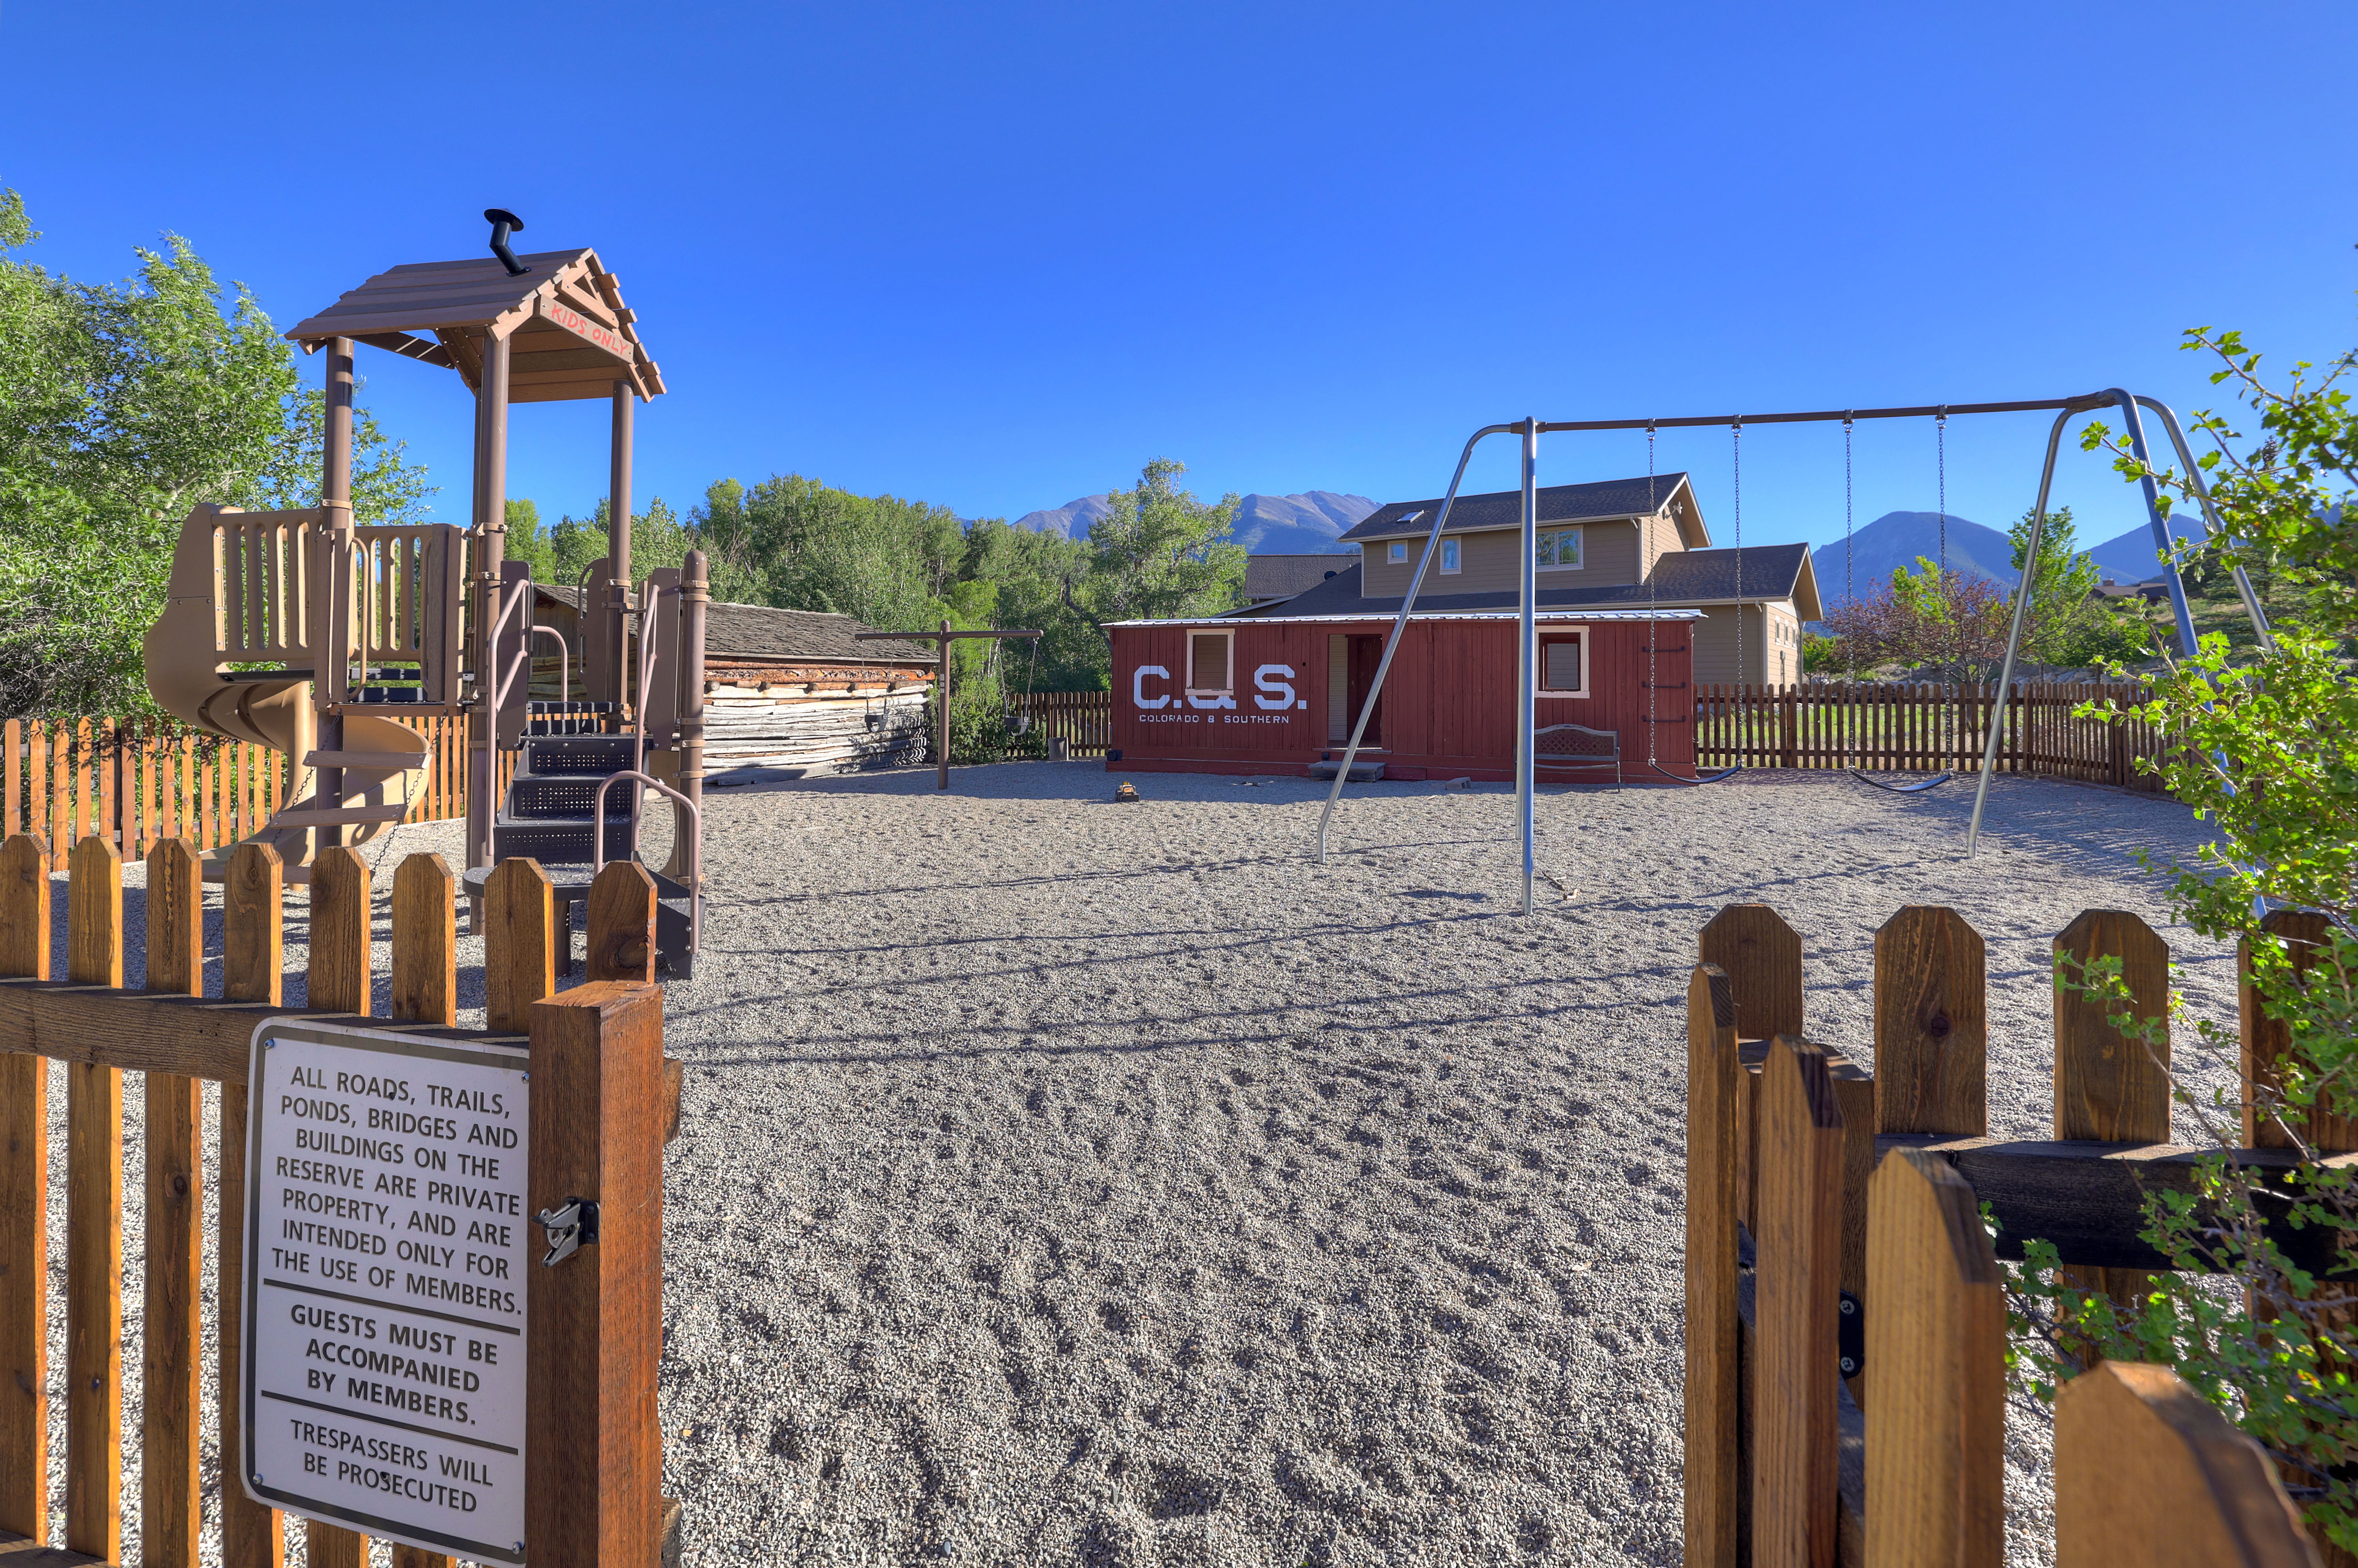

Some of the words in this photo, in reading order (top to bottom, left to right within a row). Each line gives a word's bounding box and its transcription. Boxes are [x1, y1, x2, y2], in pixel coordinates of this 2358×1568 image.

[552, 304, 587, 335] KIDS
[592, 328, 628, 355] ONLY
[1139, 714, 1199, 723] COLORADO
[1224, 715, 1289, 723] SOUTHERN
[291, 1066, 327, 1090] ALL
[337, 1072, 415, 1105] ROADS,
[428, 1084, 510, 1119] TRAILS,
[281, 1095, 356, 1128] PONDS,
[368, 1108, 456, 1140] BRIDGES
[467, 1124, 518, 1149] AND
[296, 1129, 404, 1164] BUILDINGS
[414, 1148, 447, 1171] ON
[458, 1154, 499, 1180] THE
[276, 1157, 363, 1189] RESERVE
[374, 1173, 416, 1198] ARE
[428, 1181, 520, 1216] PRIVATE
[283, 1189, 396, 1230] PROPERTY,
[407, 1211, 456, 1236] AND
[466, 1221, 510, 1248] ARE
[283, 1219, 386, 1255] INTENDED
[397, 1240, 455, 1269] ONLY
[466, 1252, 509, 1280] FOR
[272, 1248, 310, 1274] THE
[320, 1257, 357, 1282] USE
[368, 1267, 395, 1290] OF
[406, 1273, 522, 1316] MEMBERS.
[290, 1304, 376, 1339] GUESTS
[389, 1323, 456, 1355] MUST
[468, 1340, 497, 1365] BE
[305, 1338, 479, 1392] ACCOMPANIED
[308, 1368, 336, 1392] BY
[348, 1377, 475, 1425] MEMBERS.
[290, 1419, 428, 1471] TRESPASSERS
[439, 1454, 493, 1487] WILL
[304, 1452, 327, 1476] BE
[338, 1461, 477, 1513] PROSECUTED
